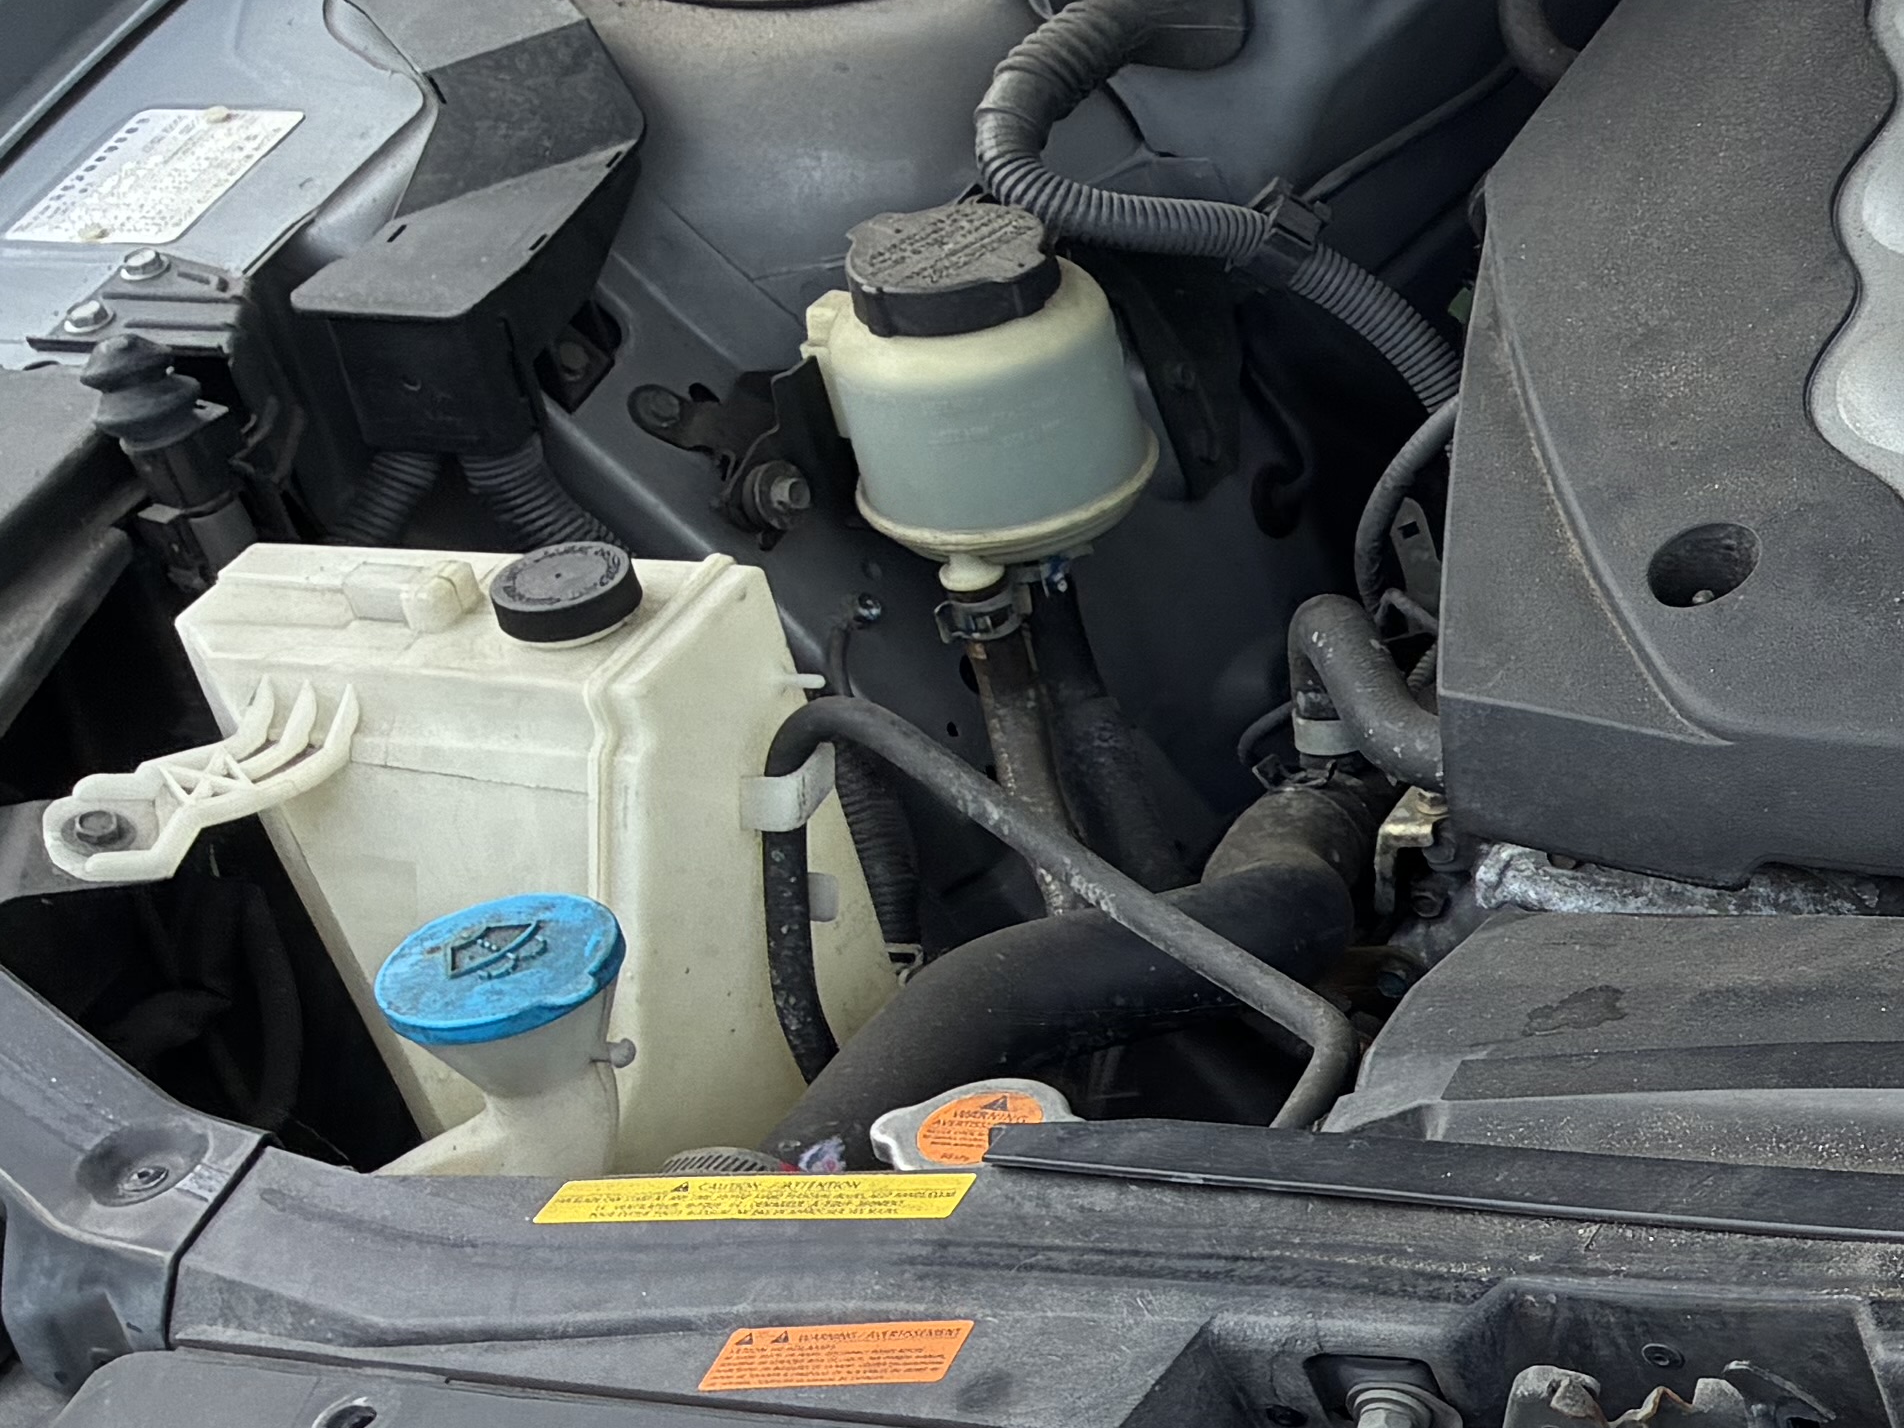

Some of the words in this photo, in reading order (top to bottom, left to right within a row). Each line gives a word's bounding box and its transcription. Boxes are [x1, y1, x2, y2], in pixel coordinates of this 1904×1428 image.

[932, 1119, 992, 1129] AVERTISS
[698, 1181, 761, 1191] CAUTION
[783, 1180, 862, 1190] ATTENTION
